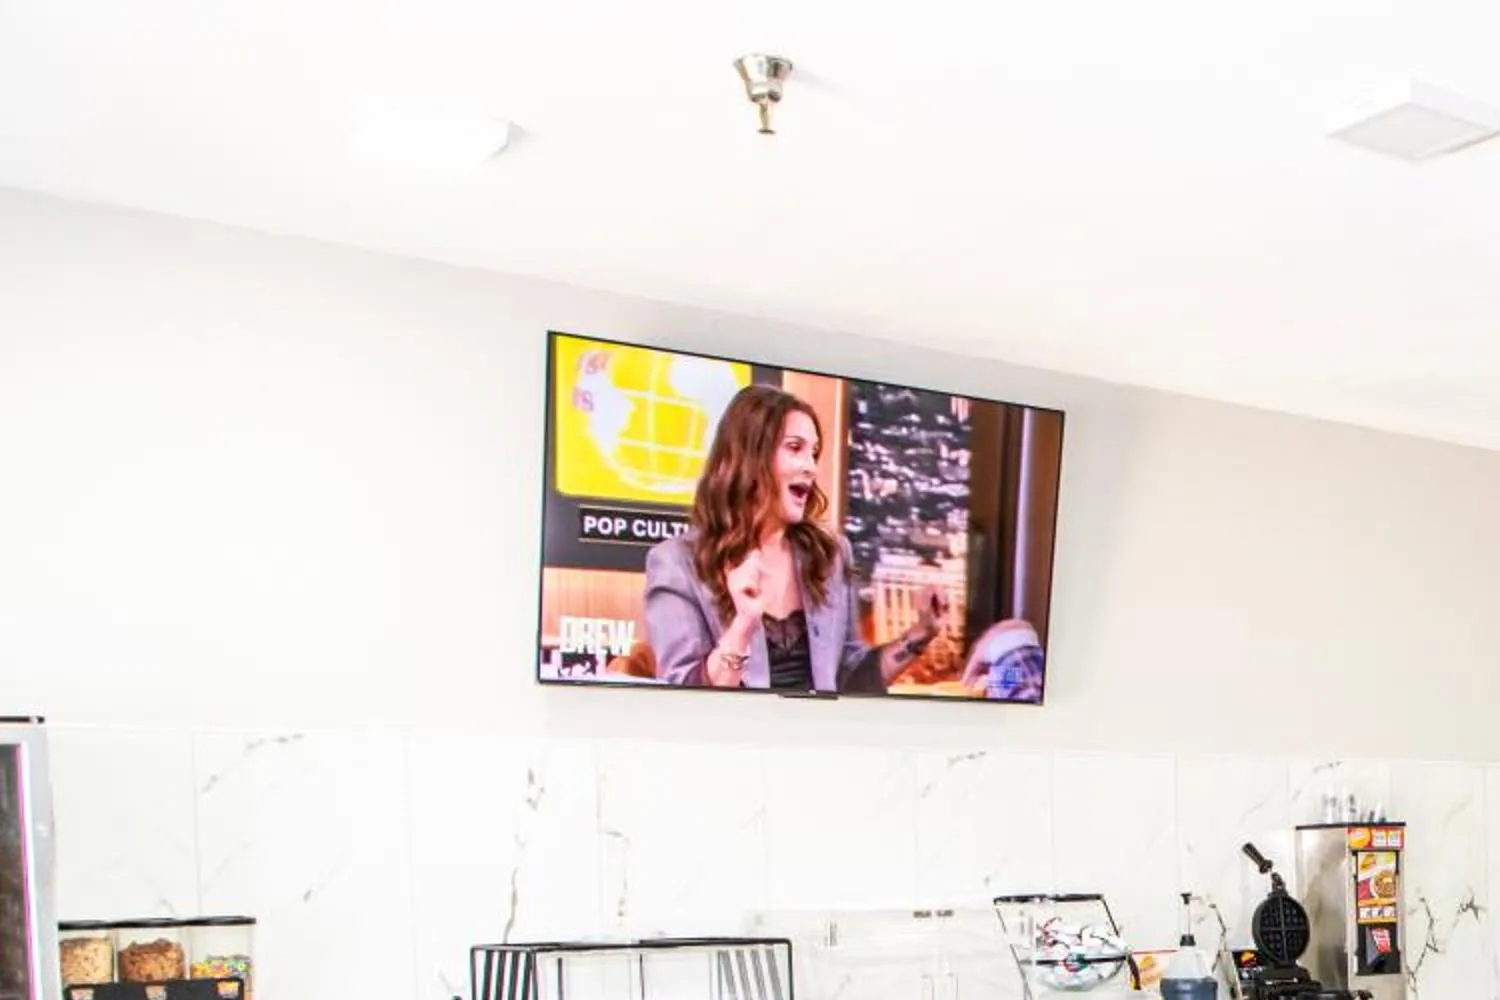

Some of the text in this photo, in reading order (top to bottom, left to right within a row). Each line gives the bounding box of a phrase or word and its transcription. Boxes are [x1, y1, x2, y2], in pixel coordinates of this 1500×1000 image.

[583, 515, 689, 540] POP CULT
[560, 615, 635, 657] DREW
